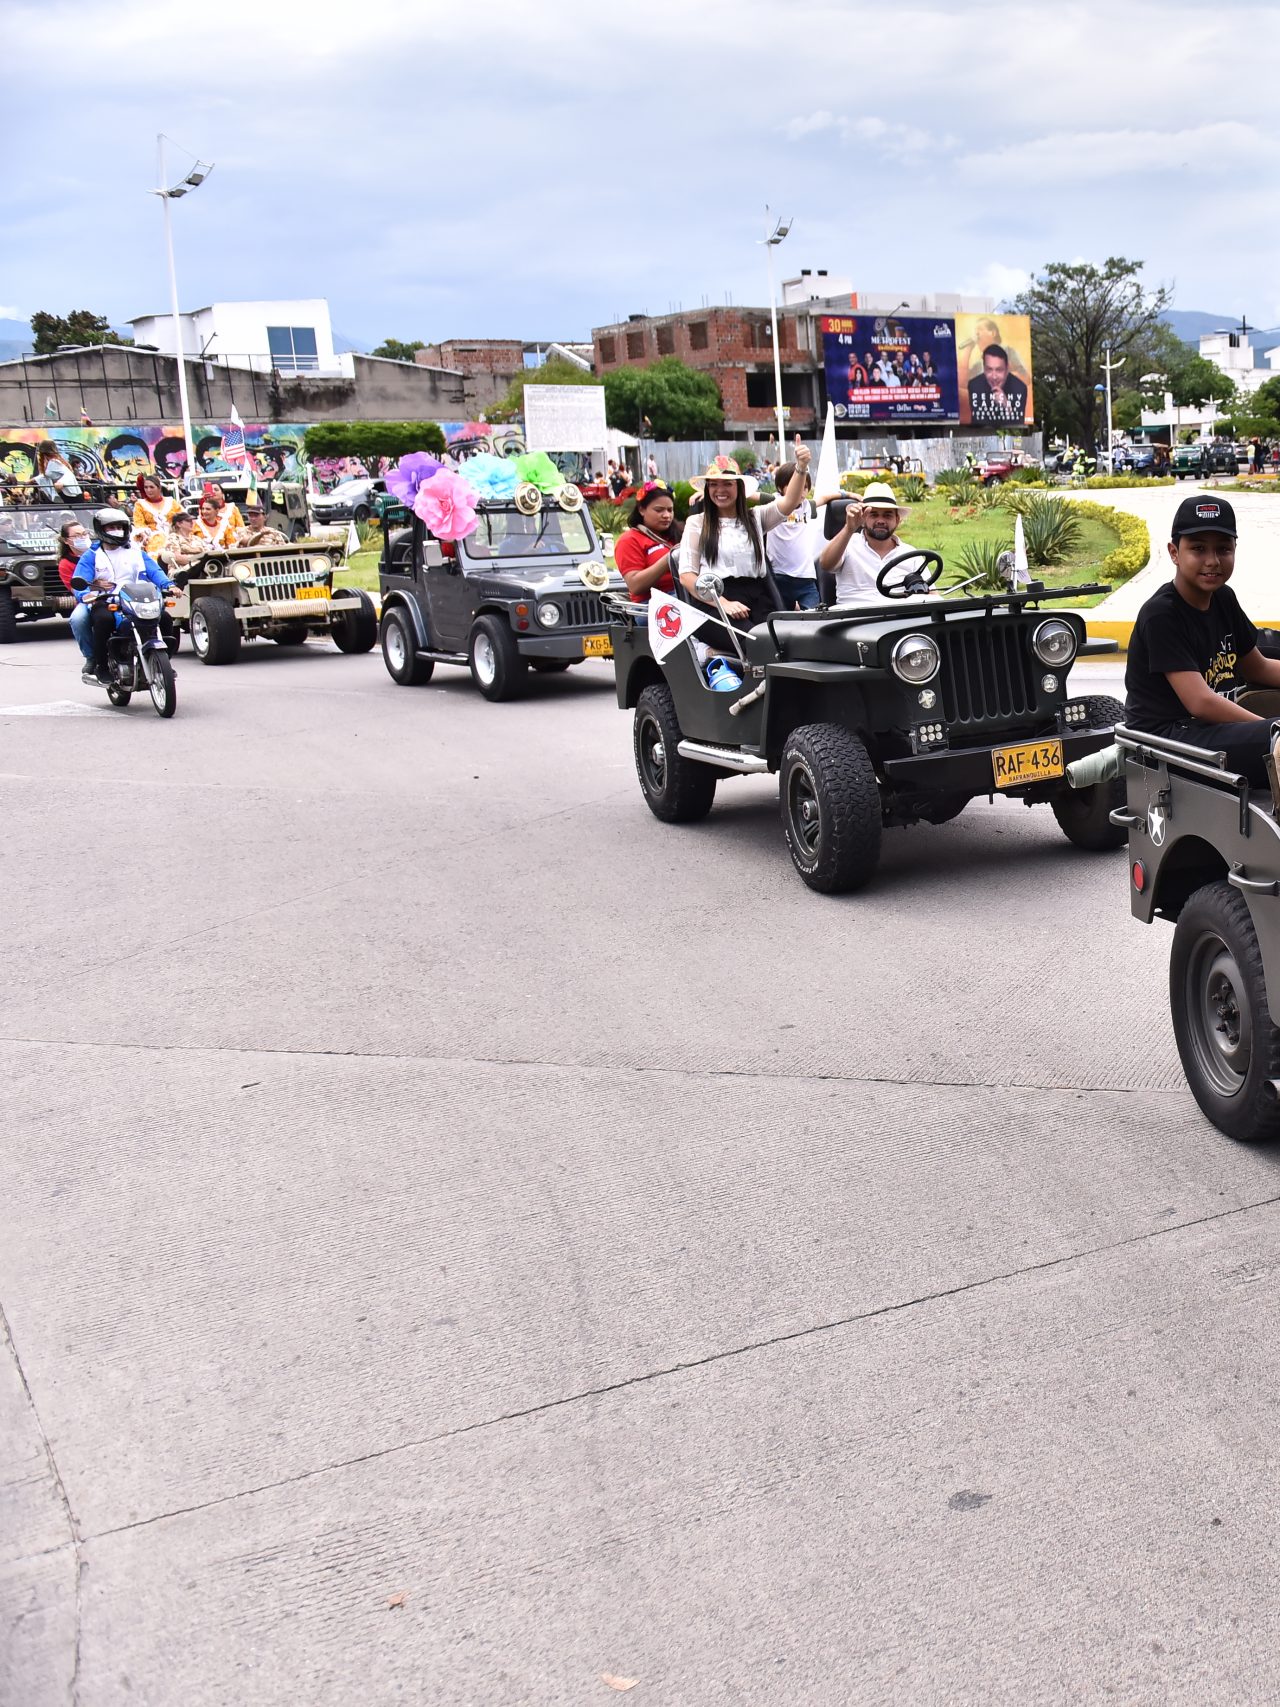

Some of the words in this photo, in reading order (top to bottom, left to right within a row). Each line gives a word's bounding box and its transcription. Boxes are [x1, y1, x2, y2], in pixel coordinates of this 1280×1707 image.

[828, 319, 841, 333] 30
[838, 333, 844, 345] 4
[972, 392, 1022, 401] PENCHY
[996, 752, 1026, 777] RAF
[1031, 746, 1060, 770] 436
[1008, 770, 1052, 782] BARRANQUILLA
